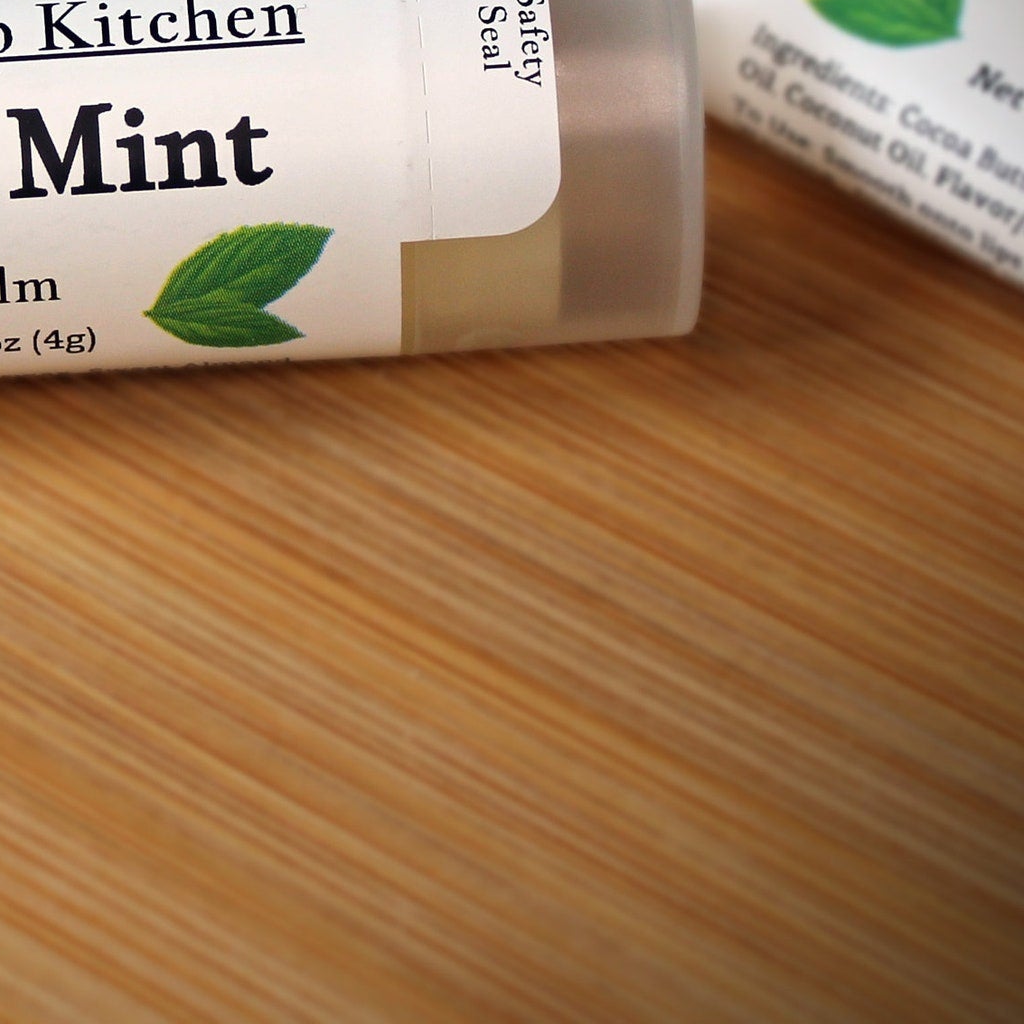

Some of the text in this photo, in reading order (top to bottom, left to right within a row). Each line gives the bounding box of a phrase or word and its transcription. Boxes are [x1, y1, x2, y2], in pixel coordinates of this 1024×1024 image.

[478, 4, 511, 72] Seal
[6, 102, 274, 200] Mint
[784, 81, 884, 155] Coconut
[898, 102, 974, 161] Cocoa
[32, 326, 98, 358] (4g)
